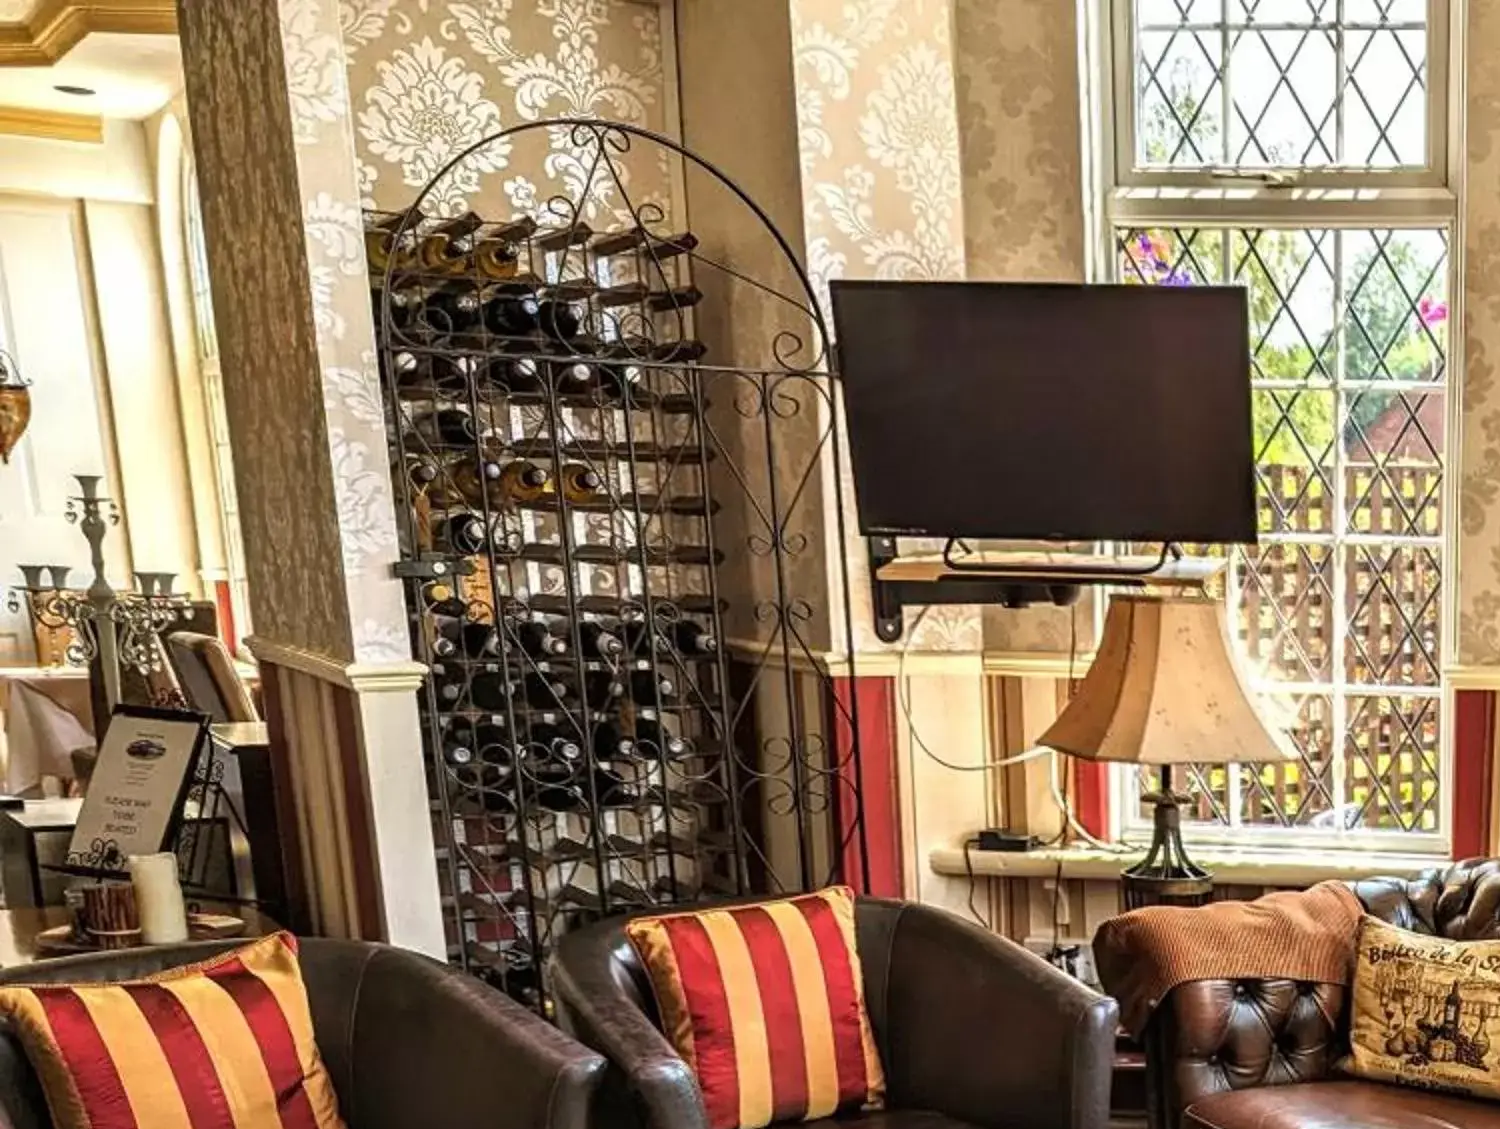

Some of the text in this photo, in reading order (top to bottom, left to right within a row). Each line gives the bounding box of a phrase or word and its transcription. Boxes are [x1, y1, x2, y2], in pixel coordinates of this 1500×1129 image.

[1368, 944, 1426, 964] Bistro
[1429, 945, 1451, 960] de
[1456, 947, 1475, 967] la
